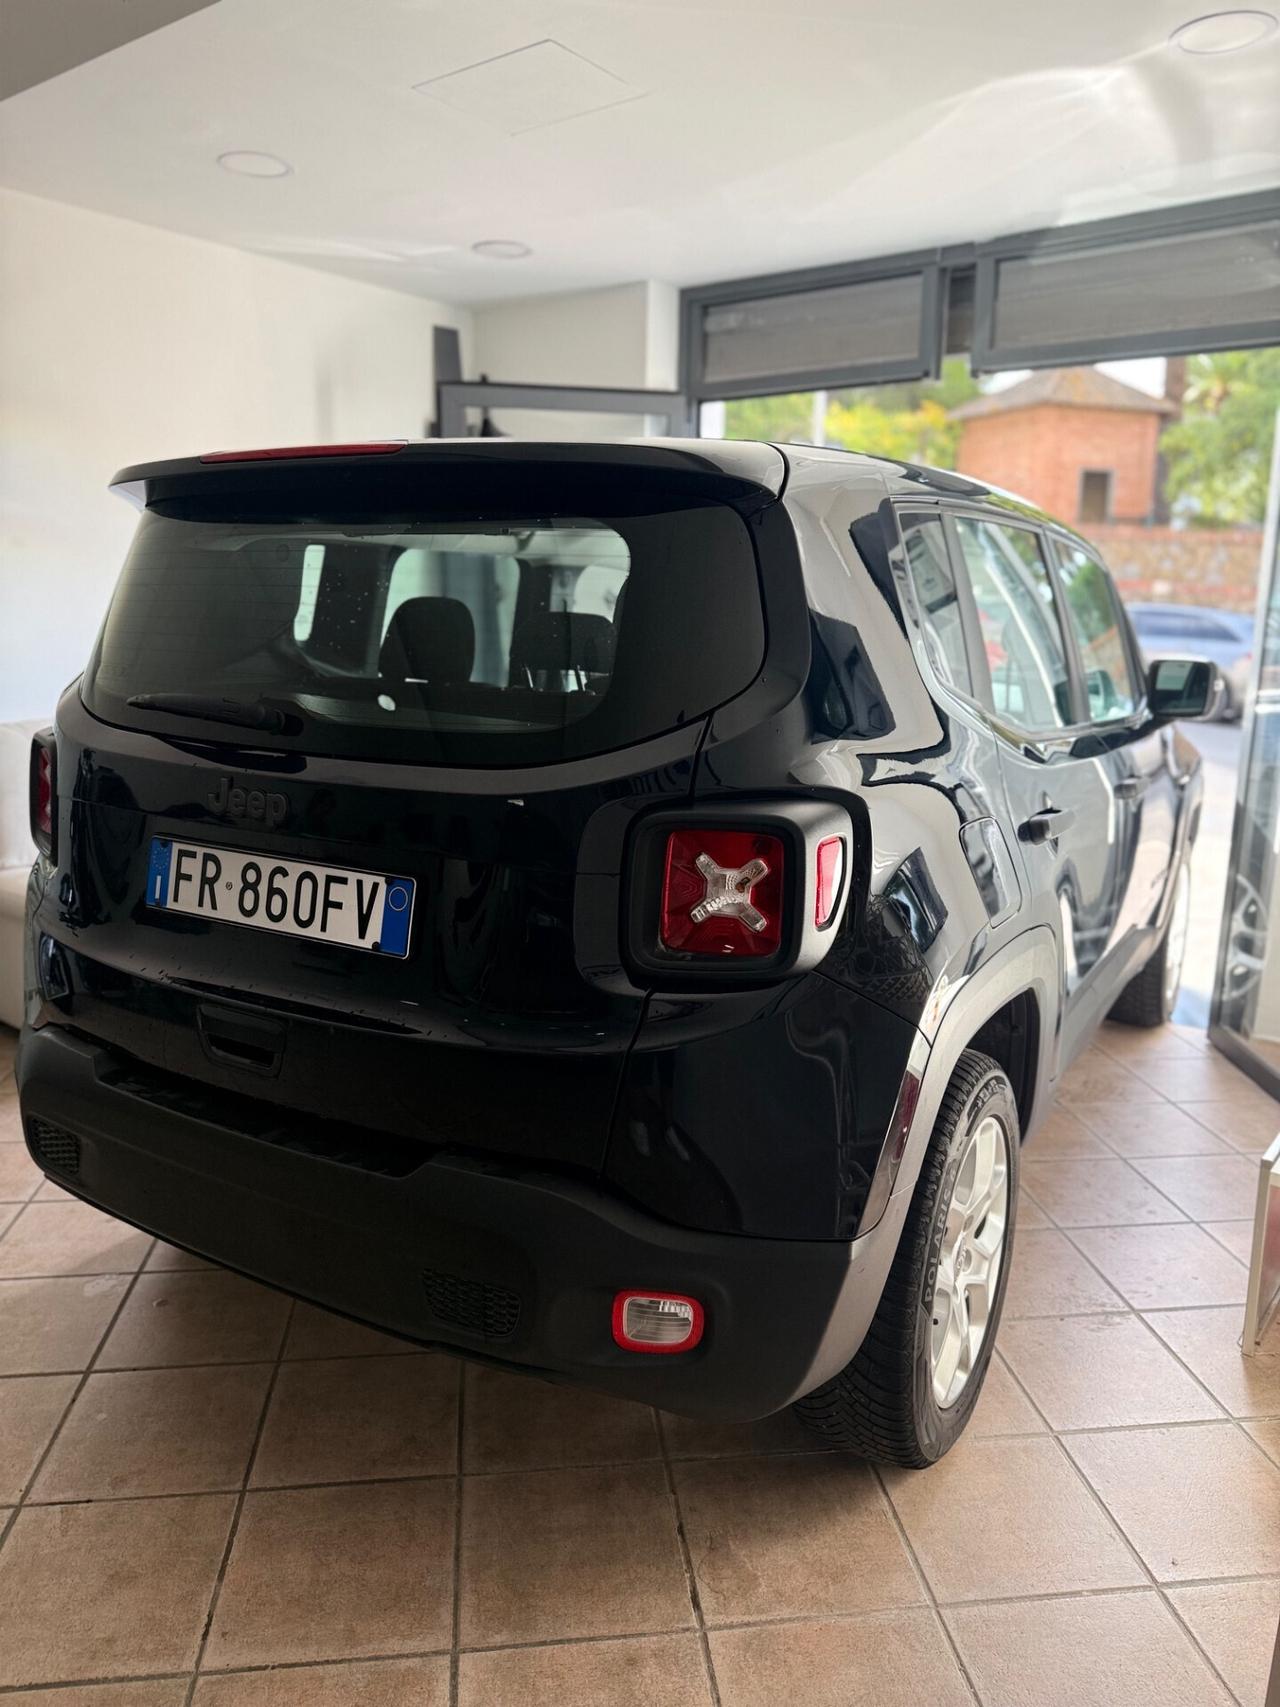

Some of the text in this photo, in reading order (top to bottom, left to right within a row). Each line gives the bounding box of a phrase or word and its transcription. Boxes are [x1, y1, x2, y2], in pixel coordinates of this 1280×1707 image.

[207, 777, 289, 826] Jeep
[155, 875, 161, 899] I
[924, 1188, 951, 1302] POLARIS
